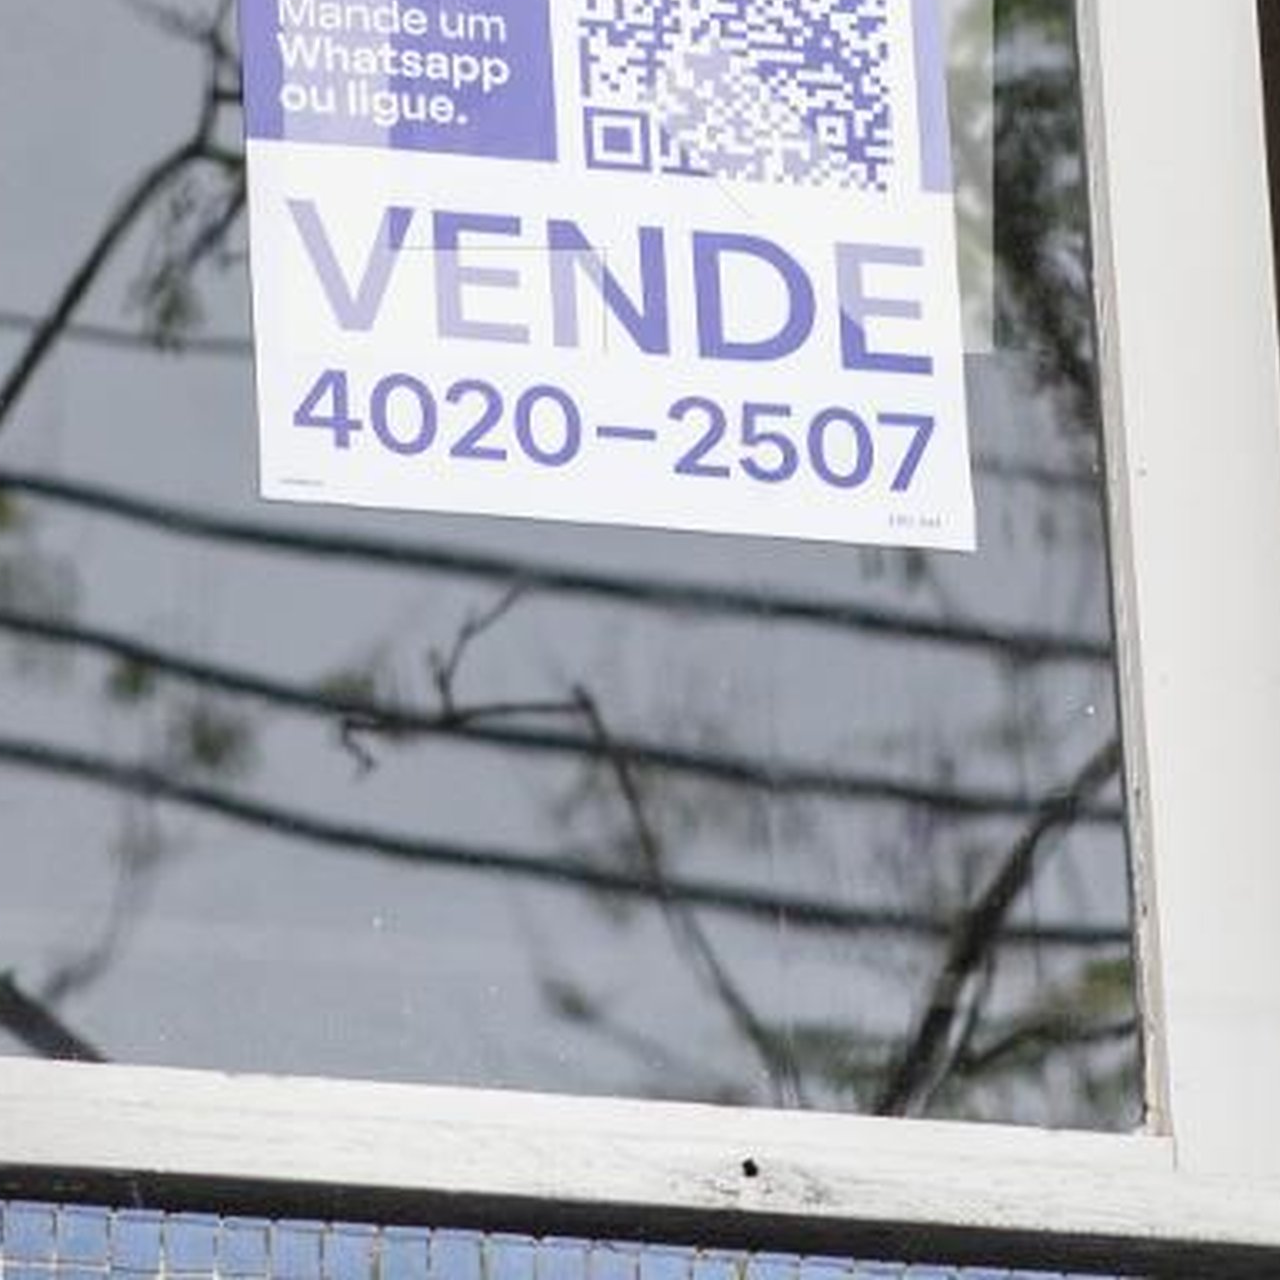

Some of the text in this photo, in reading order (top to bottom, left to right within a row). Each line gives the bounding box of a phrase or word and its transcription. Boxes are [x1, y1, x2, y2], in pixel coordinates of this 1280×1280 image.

[438, 9, 507, 43] um
[277, 31, 511, 93] Whatsapp
[280, 78, 467, 127] ou ligue.
[286, 198, 933, 376] VENDE
[293, 368, 936, 493] 4020-2507
